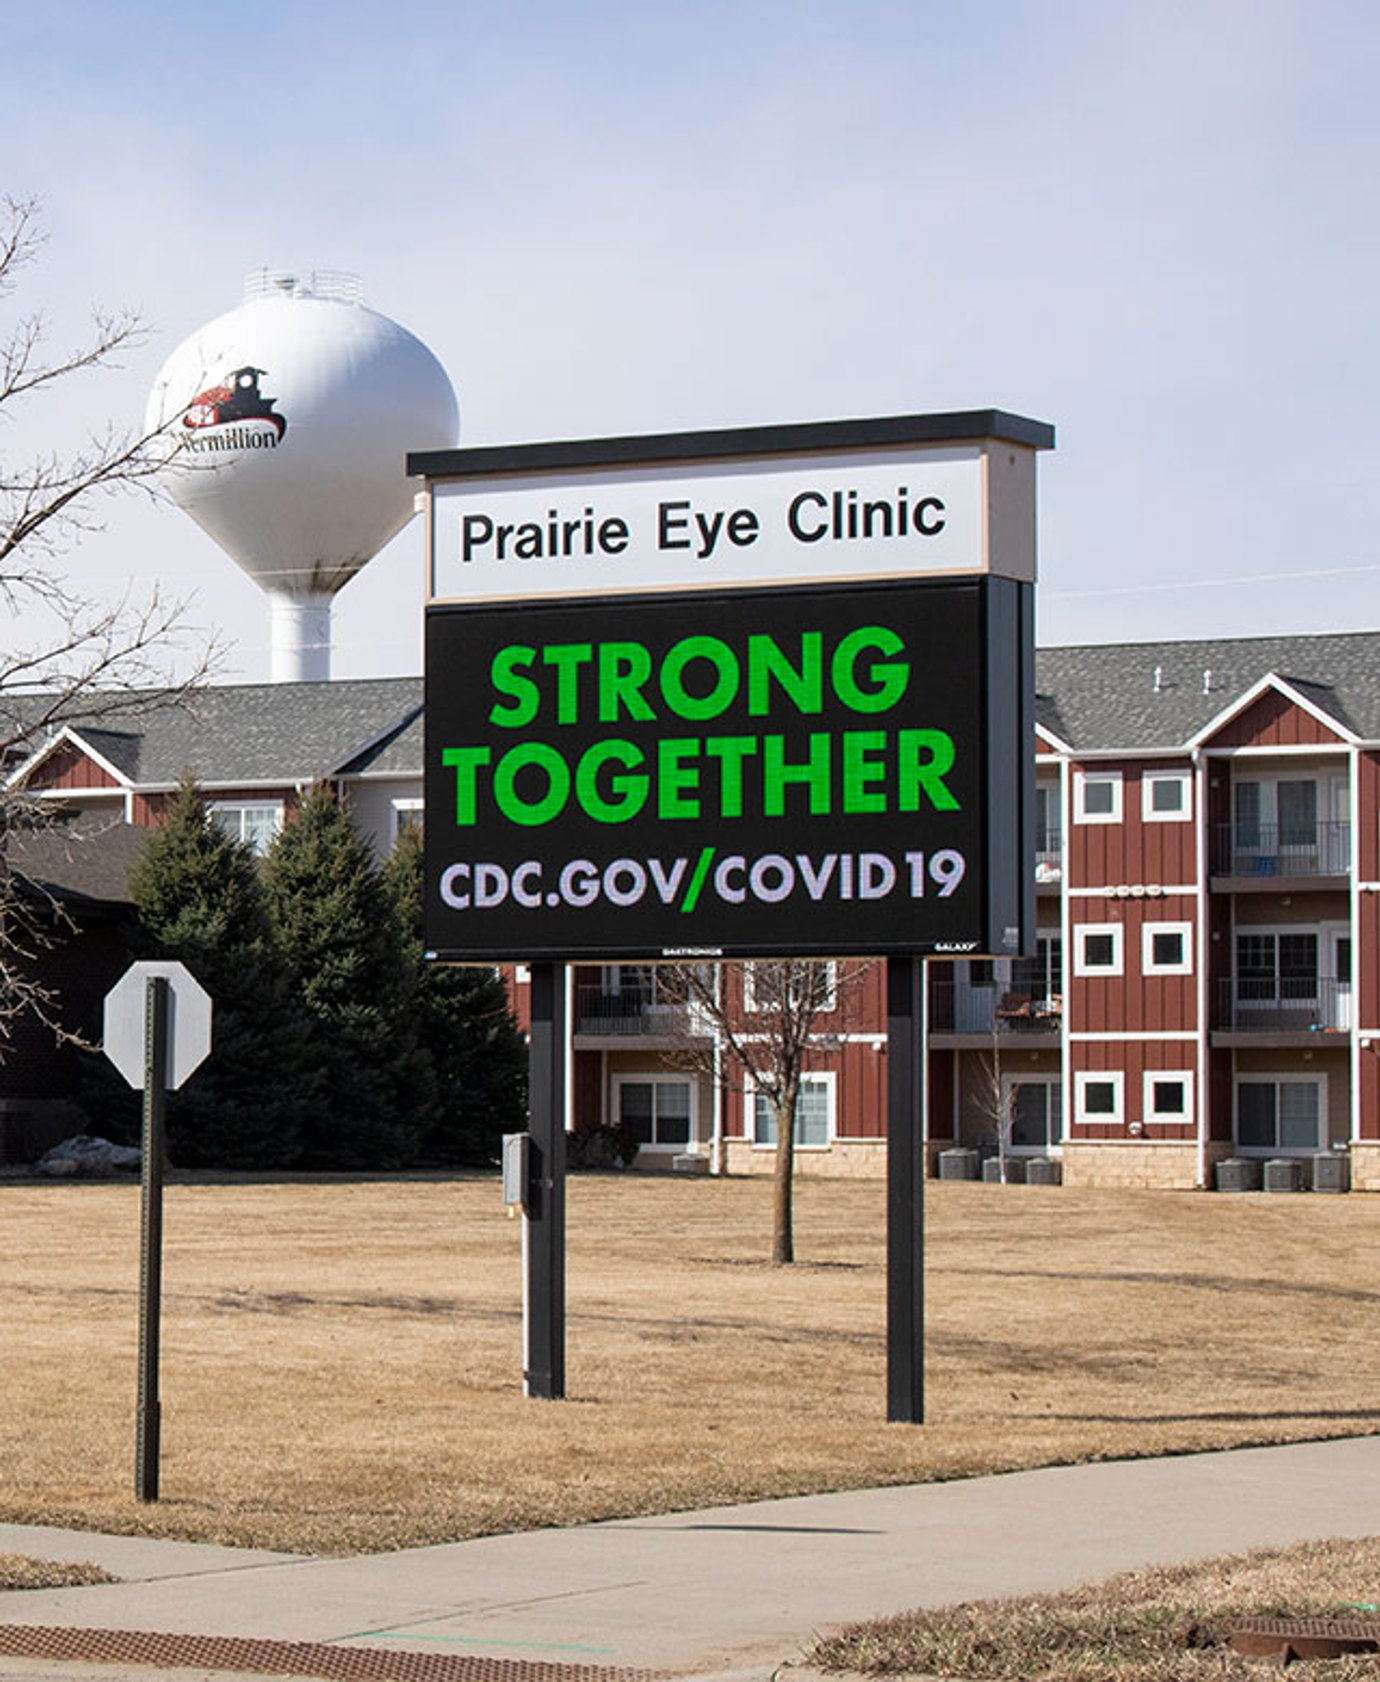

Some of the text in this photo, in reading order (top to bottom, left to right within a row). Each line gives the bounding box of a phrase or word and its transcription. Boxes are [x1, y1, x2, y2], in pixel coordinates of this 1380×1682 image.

[179, 427, 277, 453] Vermillion
[463, 487, 945, 562] Prairie Eye Clinic
[490, 627, 910, 728] STRONG
[442, 729, 961, 827] TOGETHER
